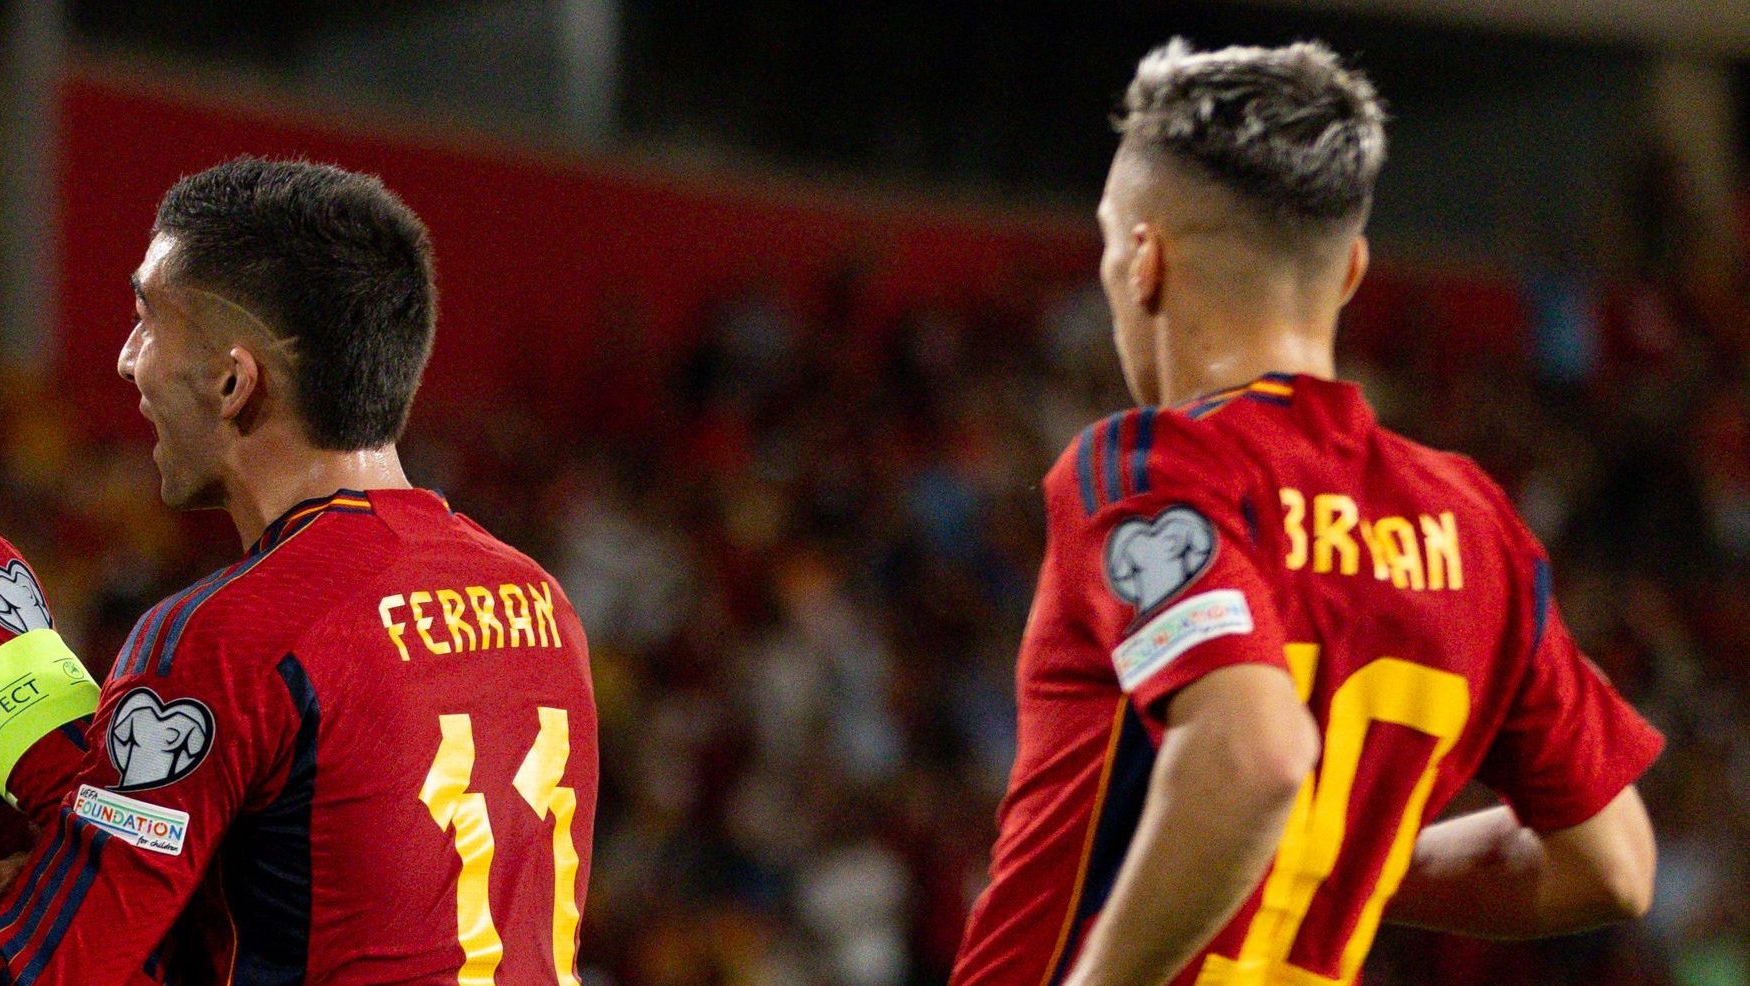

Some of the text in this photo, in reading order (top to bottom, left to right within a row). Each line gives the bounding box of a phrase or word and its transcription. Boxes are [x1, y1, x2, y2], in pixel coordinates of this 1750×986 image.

[378, 581, 562, 661] FERRAN
[80, 787, 99, 801] UEFA
[150, 840, 179, 852] children
